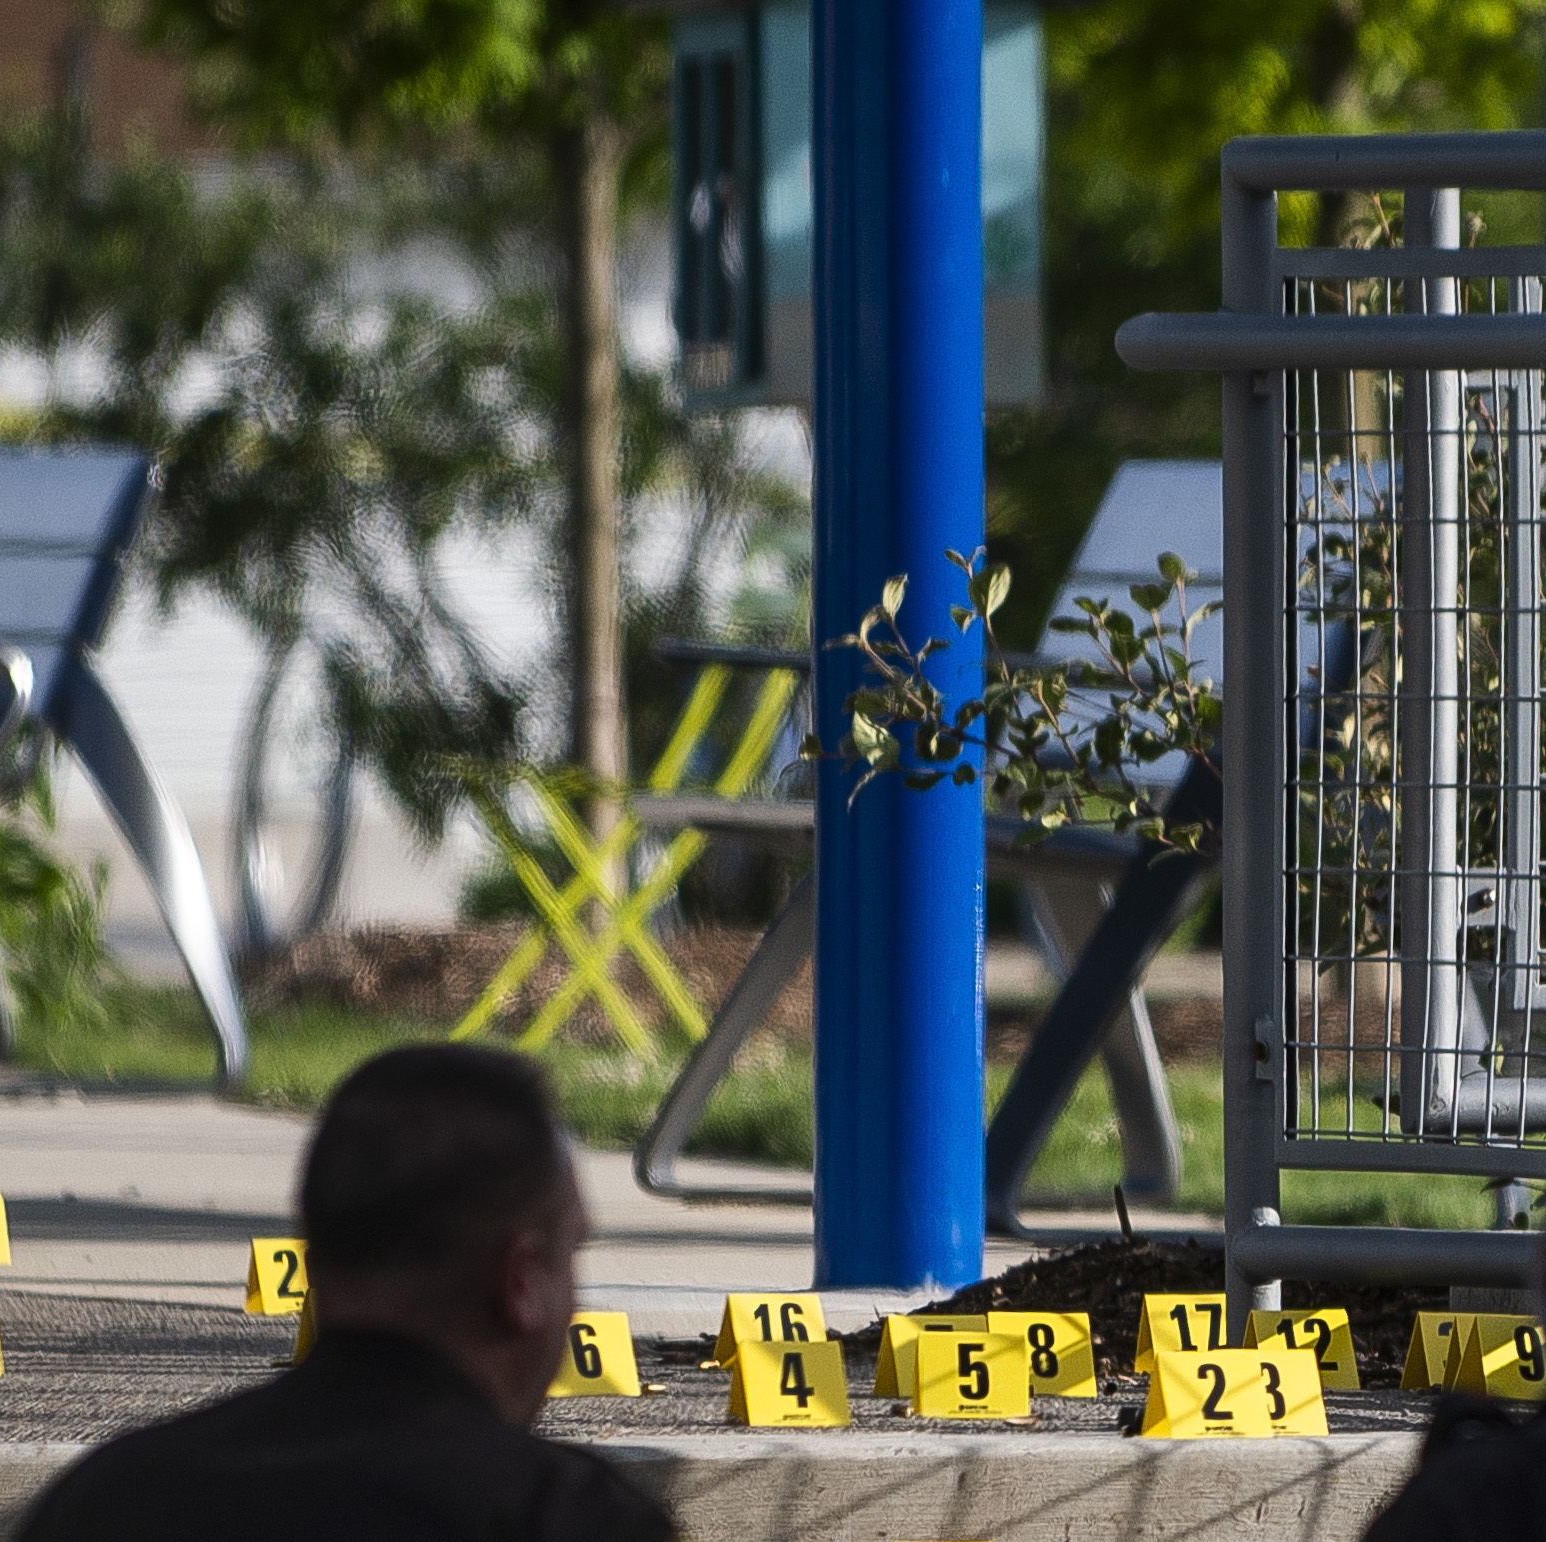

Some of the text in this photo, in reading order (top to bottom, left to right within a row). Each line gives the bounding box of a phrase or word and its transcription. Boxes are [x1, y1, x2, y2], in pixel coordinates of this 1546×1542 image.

[273, 1250, 305, 1298] 2
[754, 1303, 809, 1342] 16
[1170, 1303, 1223, 1351] 17
[1276, 1318, 1339, 1371] 12
[568, 1323, 603, 1378] 6
[957, 1343, 990, 1400] 5
[1027, 1323, 1058, 1378] 8
[1513, 1325, 1546, 1382] 9
[780, 1352, 815, 1408] 4
[1197, 1363, 1234, 1420] 2
[1260, 1361, 1286, 1420] 3
